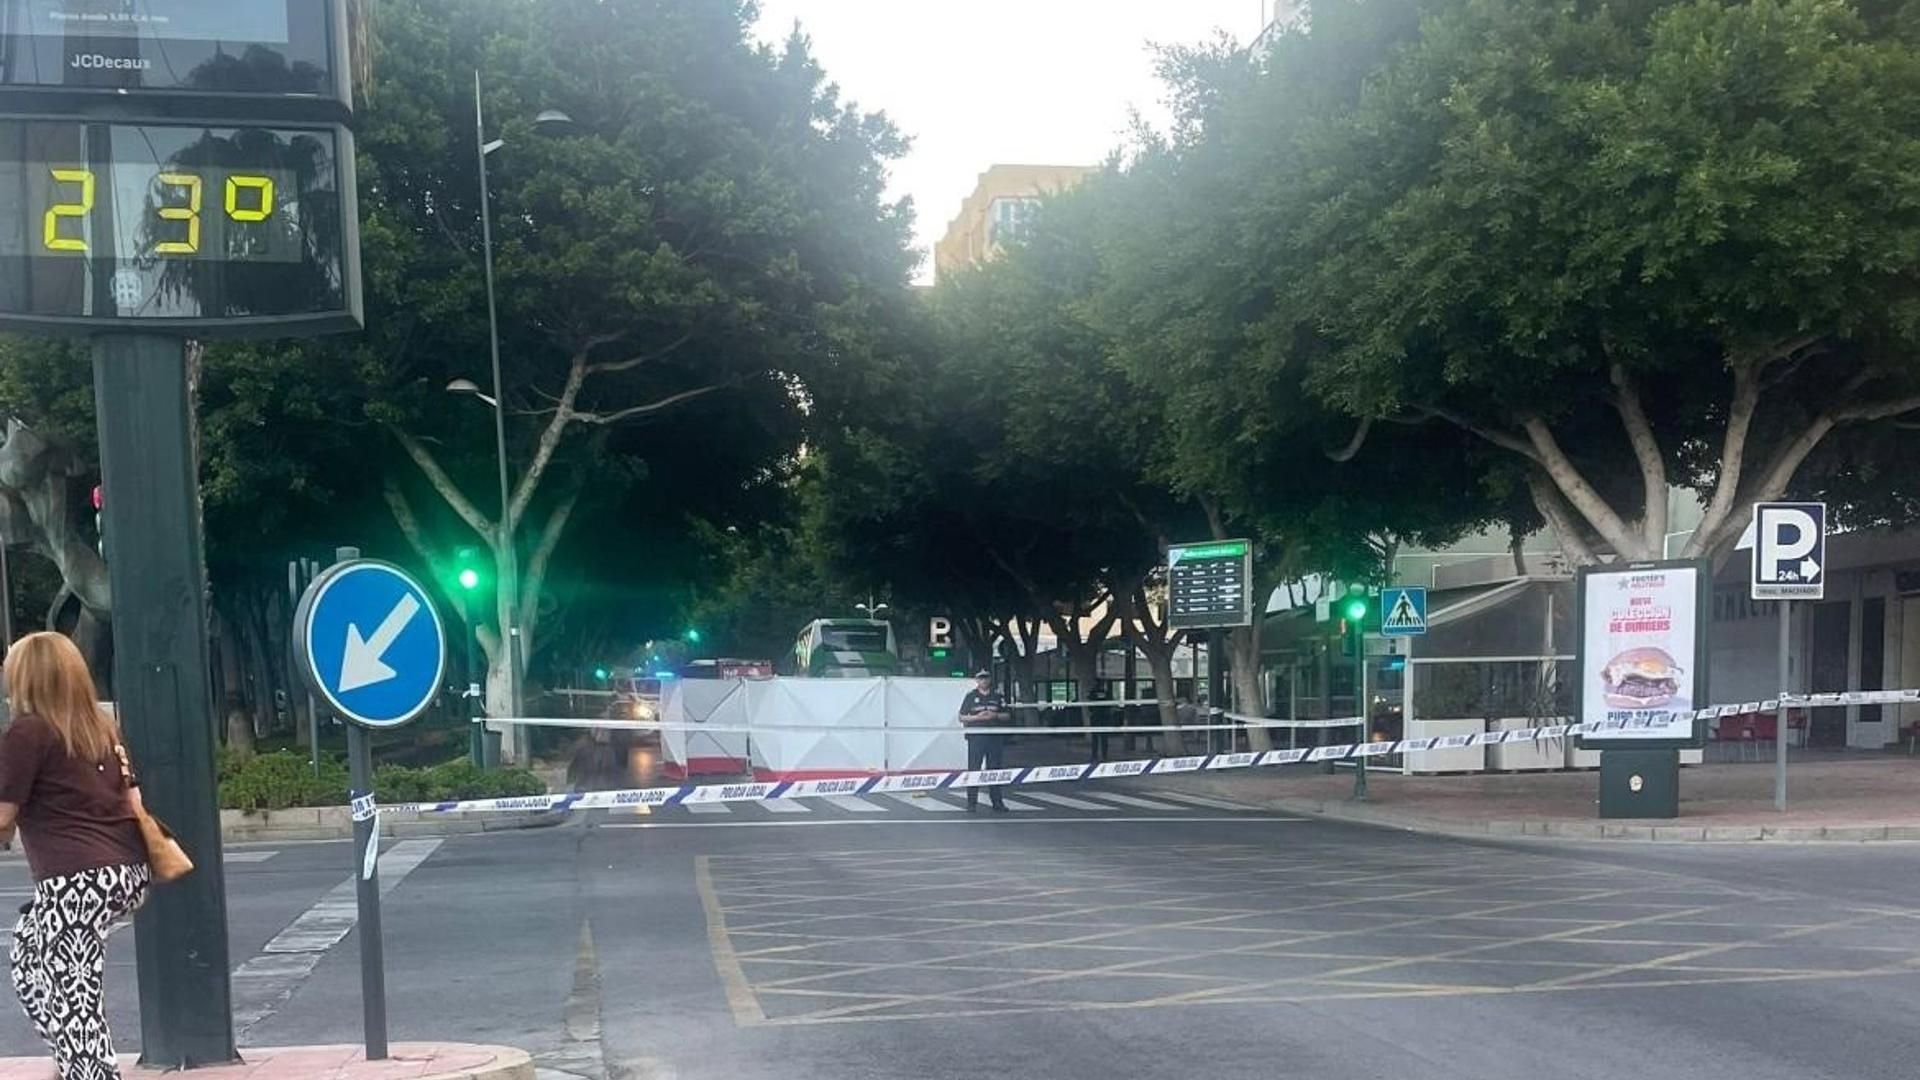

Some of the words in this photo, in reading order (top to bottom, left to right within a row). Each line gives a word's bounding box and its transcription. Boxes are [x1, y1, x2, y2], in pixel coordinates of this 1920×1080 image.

[71, 54, 151, 69] JCDecaux
[1761, 508, 1817, 581] P
[1778, 570, 1800, 581] 24h
[1610, 622, 1622, 632] DE
